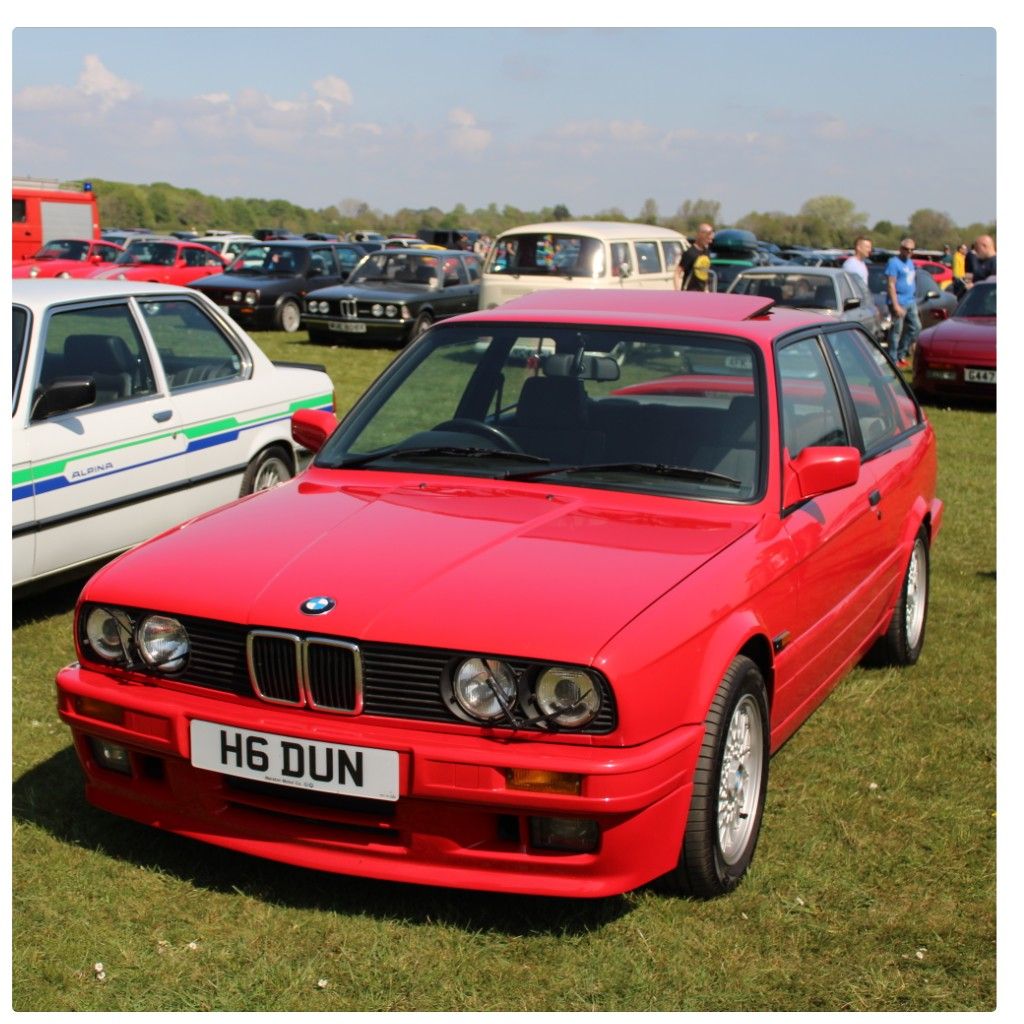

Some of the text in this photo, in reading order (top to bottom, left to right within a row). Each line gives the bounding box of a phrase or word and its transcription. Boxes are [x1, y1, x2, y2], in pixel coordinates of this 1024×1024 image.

[72, 462, 114, 478] ALPINA
[220, 730, 363, 787] H6 DUN
